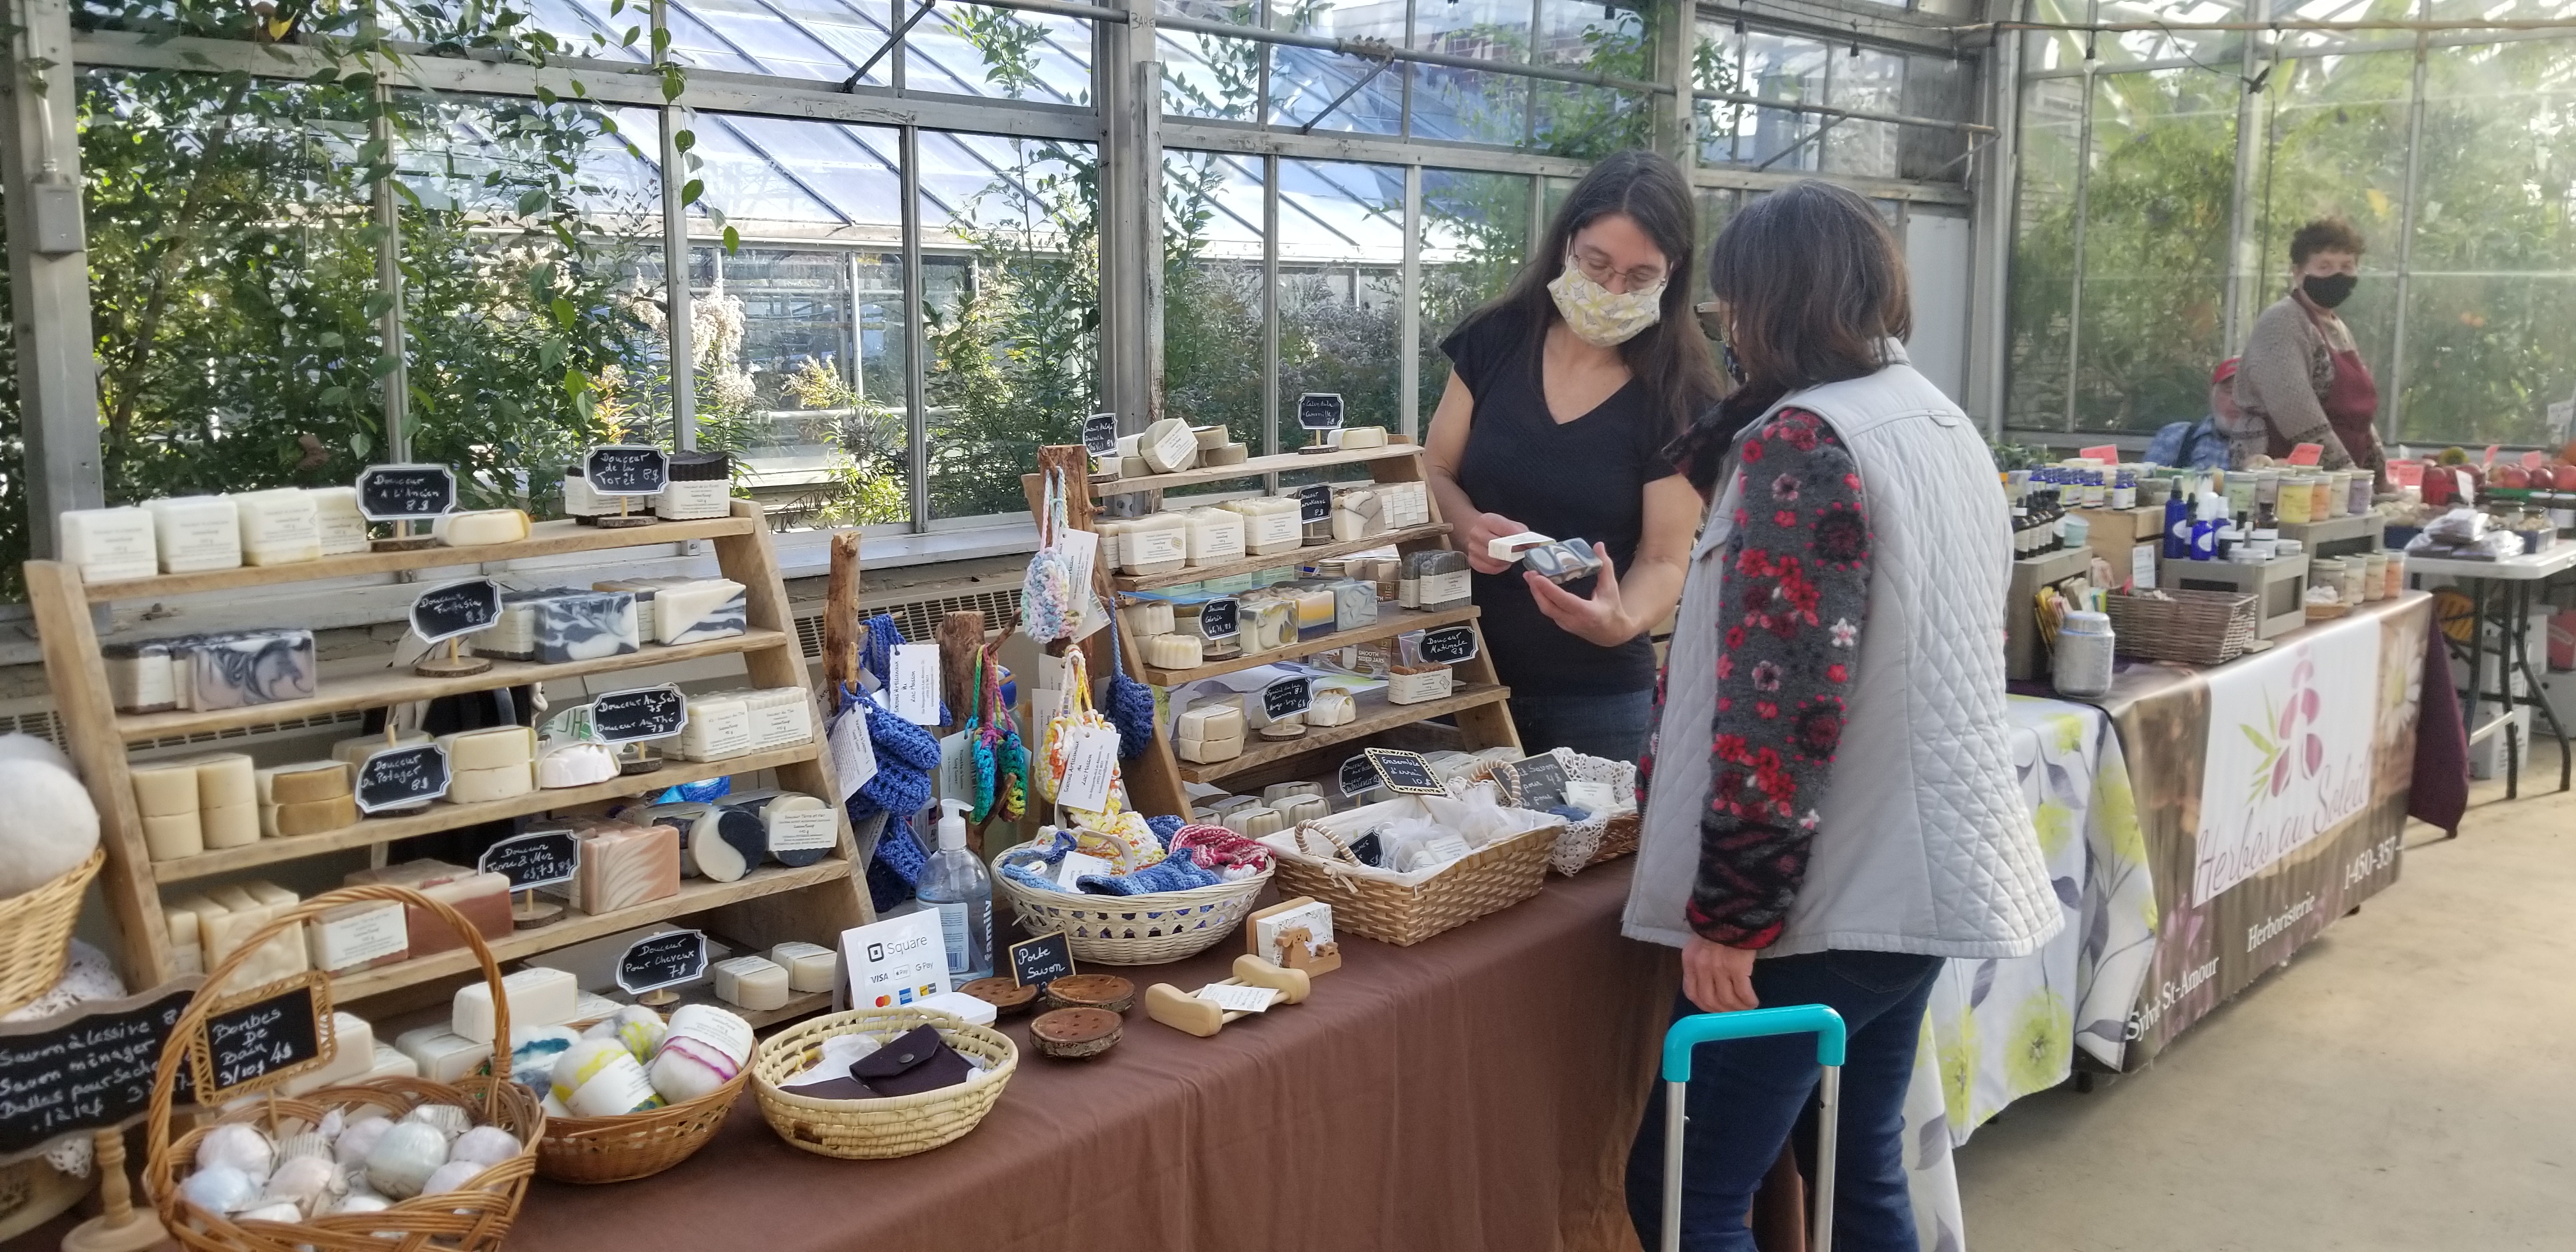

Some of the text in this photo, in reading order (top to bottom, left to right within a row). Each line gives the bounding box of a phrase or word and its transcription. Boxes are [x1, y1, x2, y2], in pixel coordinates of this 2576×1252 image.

[599, 452, 650, 462] Douceur
[373, 475, 425, 485] Douceur
[643, 468, 660, 484] 8$
[1426, 631, 1462, 645] Douceur
[599, 699, 641, 712] Douceur
[658, 692, 676, 705] Sel
[597, 722, 636, 732] Douceur
[652, 712, 676, 723] Thé
[374, 754, 421, 771] Douceur
[1064, 740, 1080, 793] Savons Artisanaux
[1084, 754, 1092, 774] Masson
[1381, 756, 1421, 767] Ensemble
[1529, 763, 1558, 773] Savon
[376, 765, 422, 783] Potager
[1523, 773, 1563, 794] pour 4$
[1533, 793, 1554, 805] pour
[2193, 747, 2373, 906] Herbes au Soleil
[501, 844, 549, 858] Douceur
[530, 851, 553, 864] Mer
[983, 900, 993, 962] family
[2247, 891, 2315, 953] Herboristerie
[638, 938, 687, 957] Douceur
[887, 936, 928, 955] Square
[1018, 946, 1051, 965] Porte
[625, 961, 651, 972] Pour
[870, 973, 889, 984] VISA
[923, 961, 934, 970] Pay
[1027, 963, 1066, 979] Savon
[2163, 957, 2220, 1011] St-Amour
[212, 1009, 282, 1045] Bombes
[220, 1042, 268, 1066] Bain
[71, 1075, 113, 1103] pour
